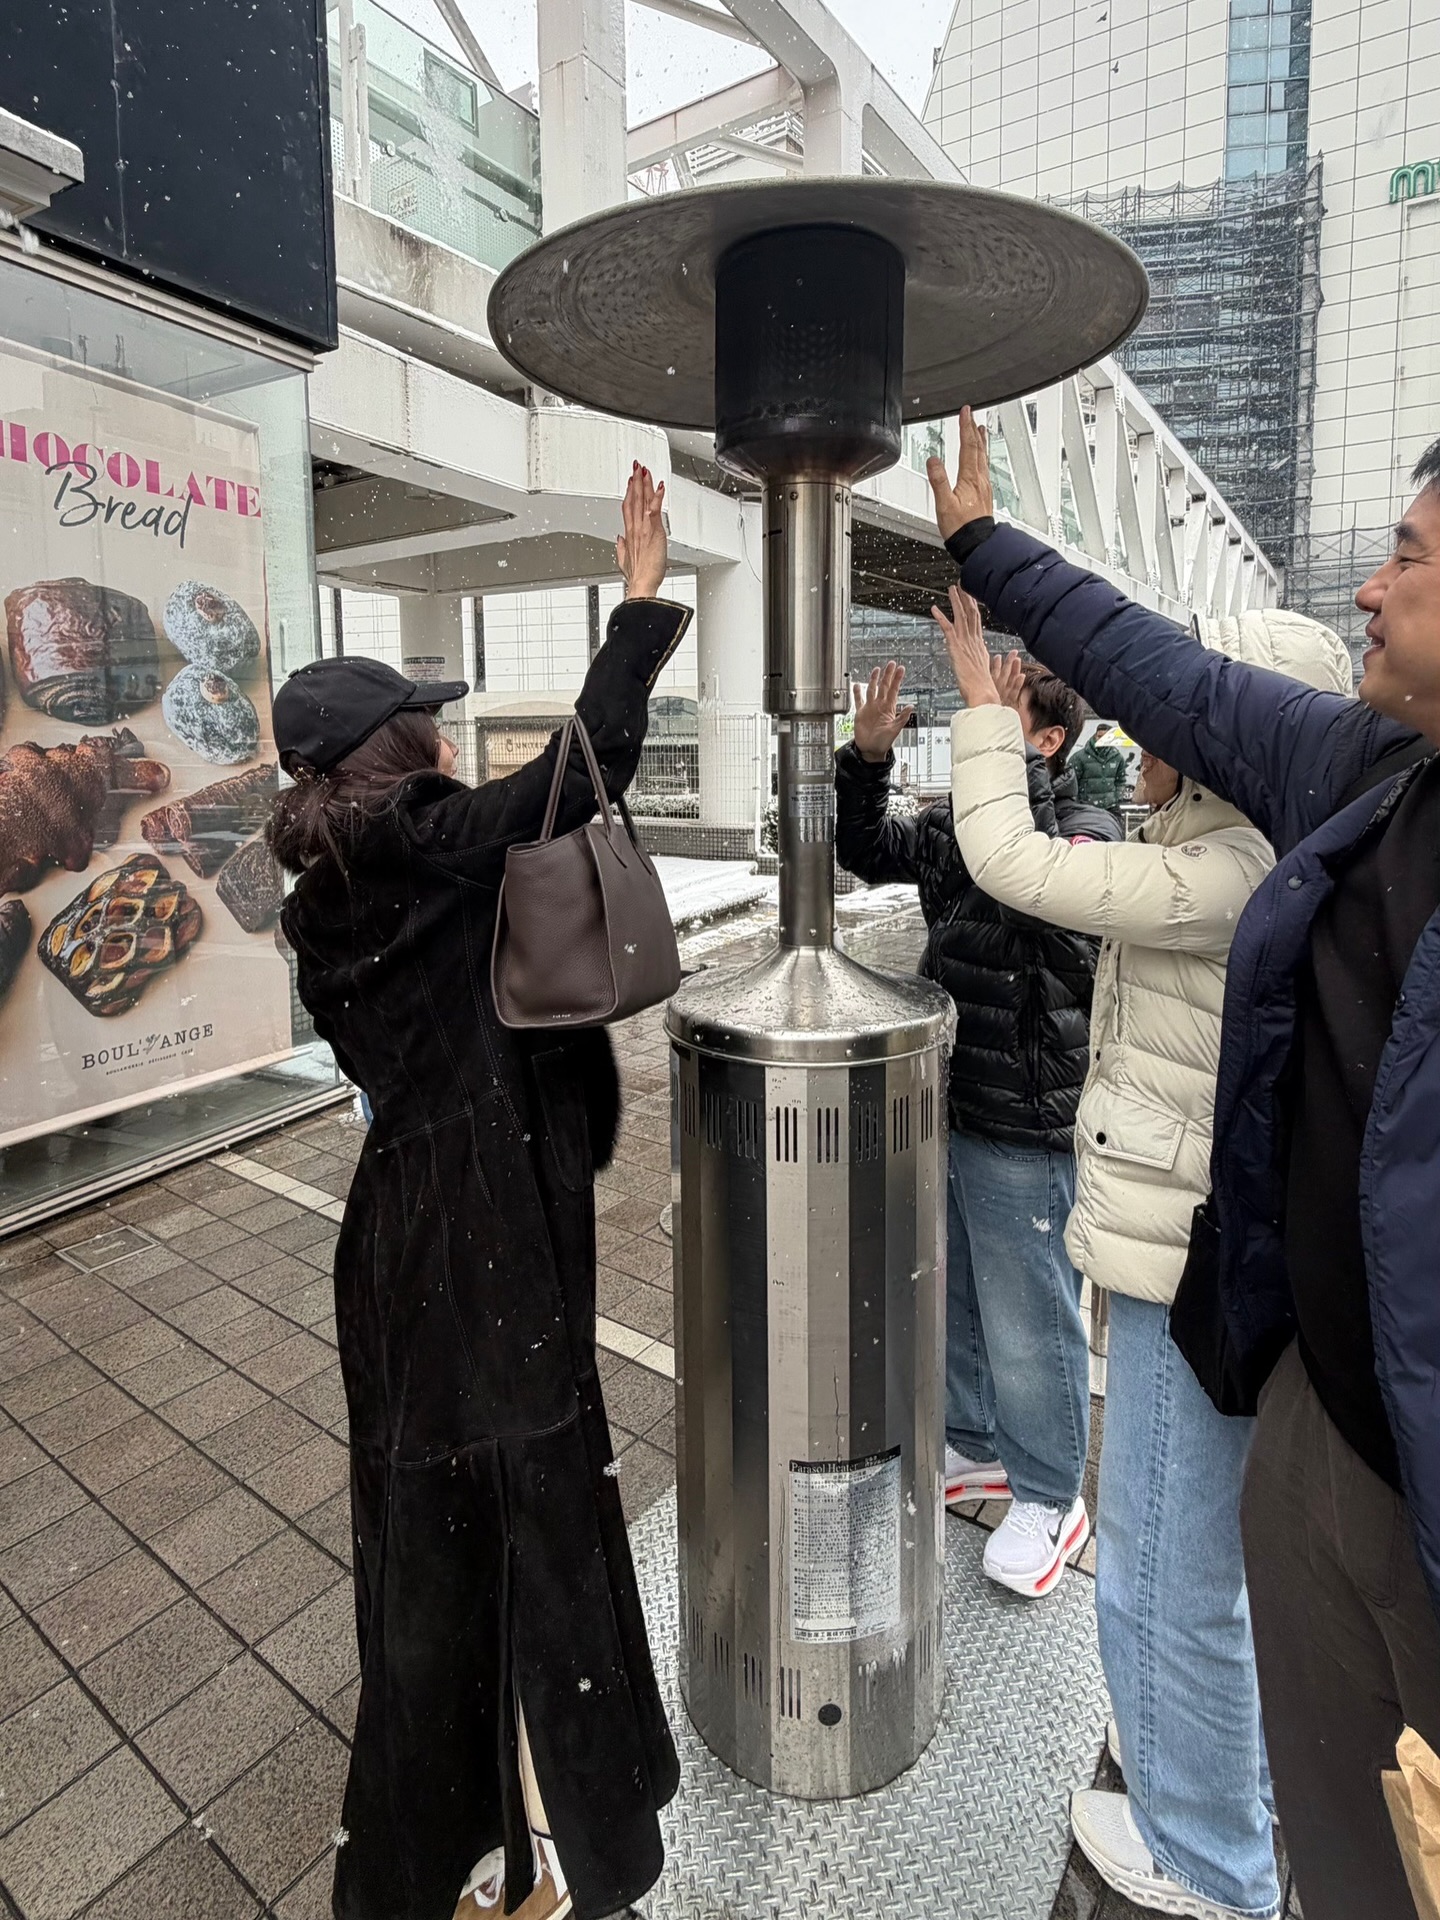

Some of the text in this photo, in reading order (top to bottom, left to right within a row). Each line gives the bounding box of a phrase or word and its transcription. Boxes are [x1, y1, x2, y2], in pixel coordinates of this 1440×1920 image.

[1390, 161, 1440, 204] m
[45, 461, 194, 549] Bread
[791, 1462, 858, 1473] Parasol Heater
